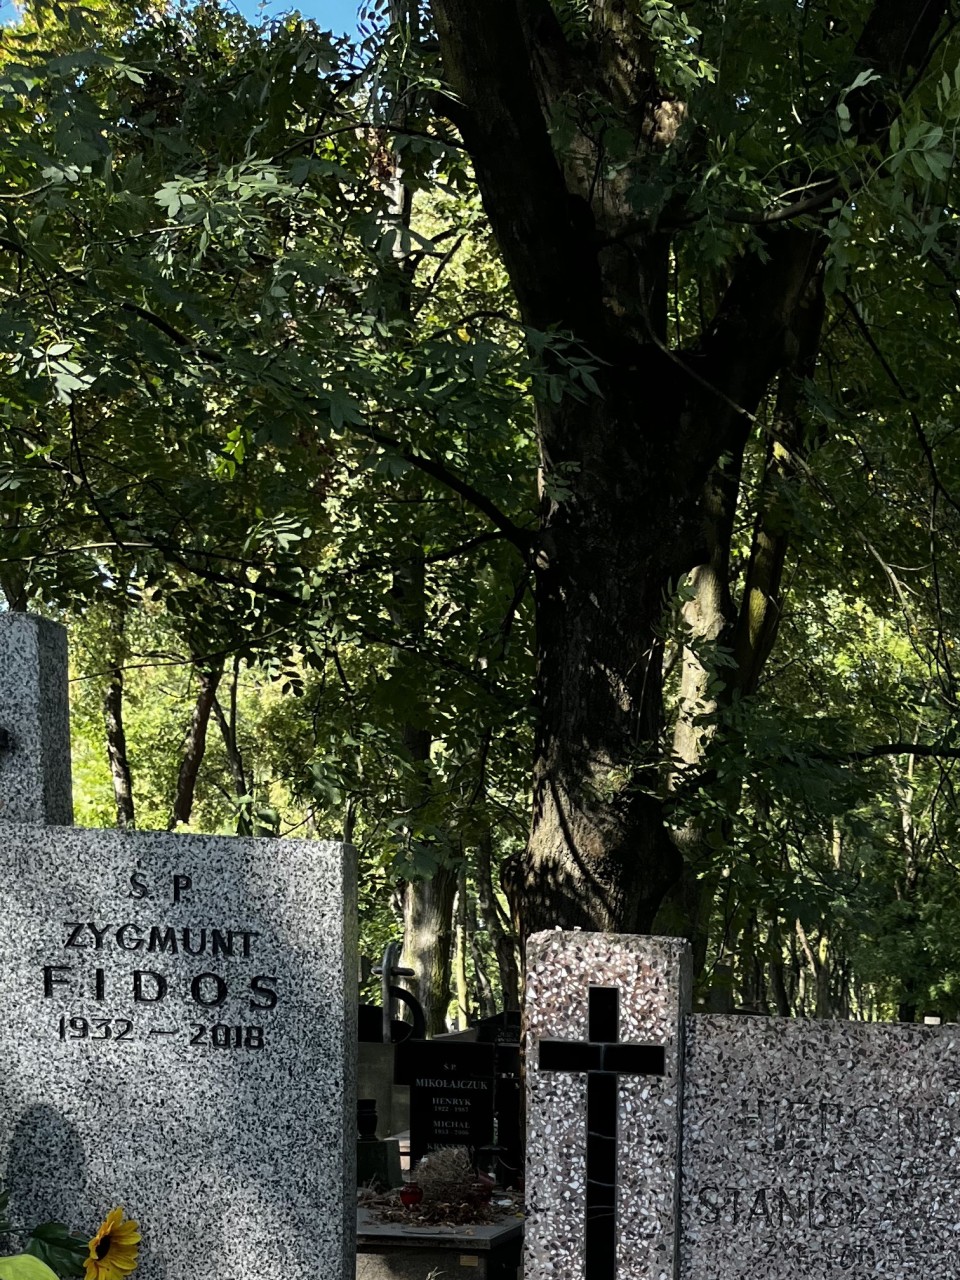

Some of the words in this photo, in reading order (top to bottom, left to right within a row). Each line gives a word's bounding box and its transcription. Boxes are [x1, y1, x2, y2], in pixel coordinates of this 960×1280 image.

[63, 921, 259, 957] ZYGMUNT
[41, 965, 278, 1011] FIDOS
[59, 1016, 134, 1041] 1932
[189, 1023, 265, 1050] 2018
[415, 1078, 488, 1090] MIKOŁAJCZUK
[432, 1097, 472, 1106] HENRYK
[433, 1120, 471, 1129] MICHAŁ
